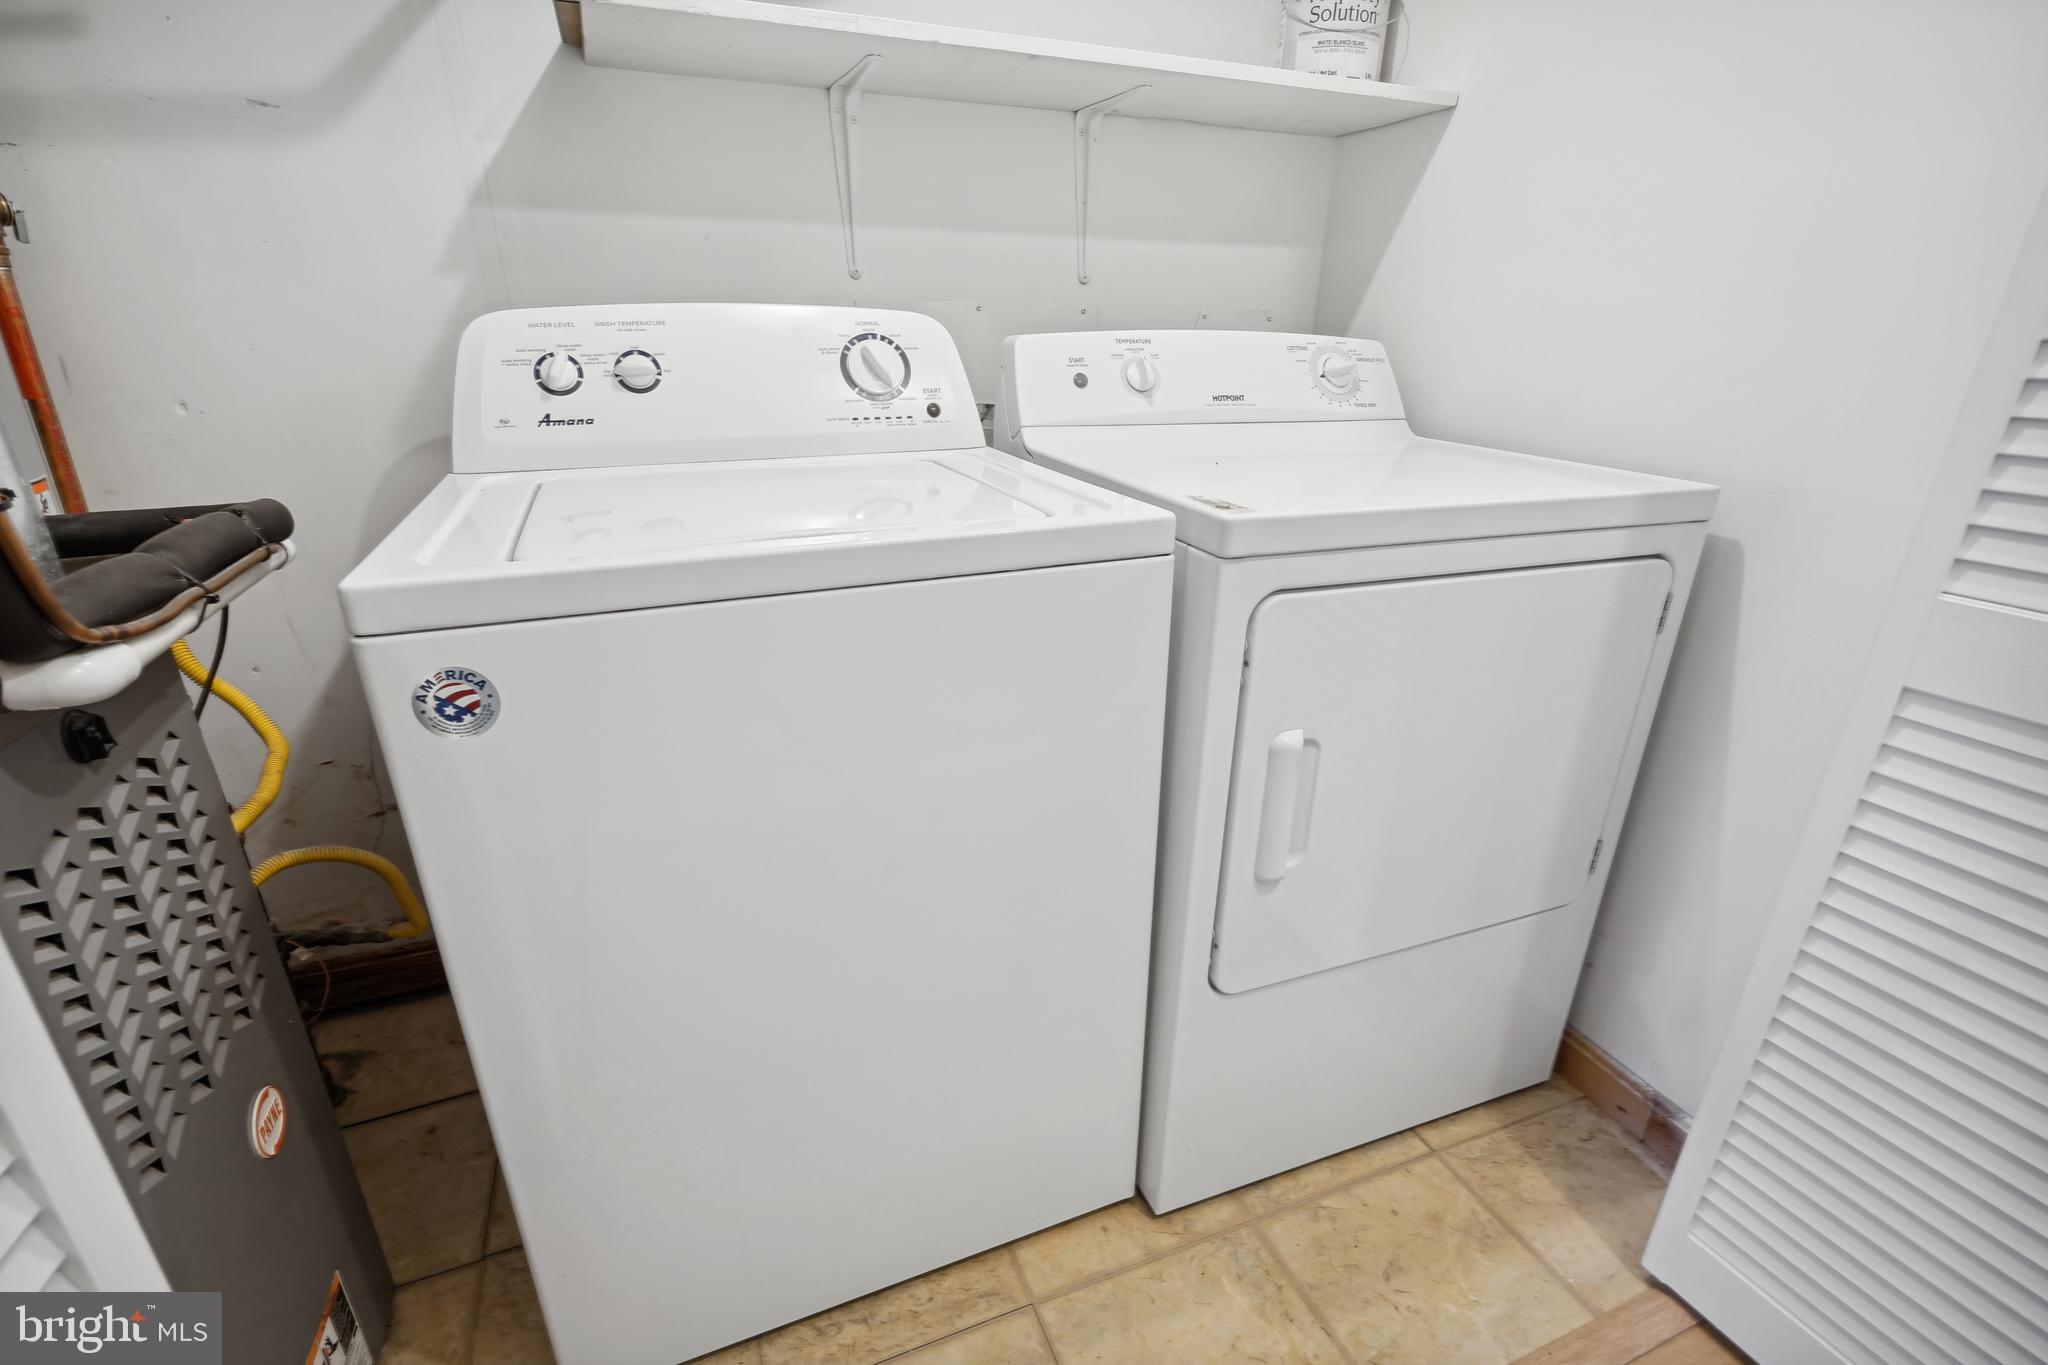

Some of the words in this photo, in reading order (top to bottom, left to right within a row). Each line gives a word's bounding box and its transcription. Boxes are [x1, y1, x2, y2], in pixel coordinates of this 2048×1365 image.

[1309, 2, 1377, 24] Solution
[617, 319, 666, 327] TEMPERATURE
[922, 387, 941, 395] START
[1212, 394, 1245, 402] HOTPOINT
[537, 413, 595, 428] Amana
[415, 669, 487, 704] AMERICA
[260, 1097, 282, 1145] PAYNE
